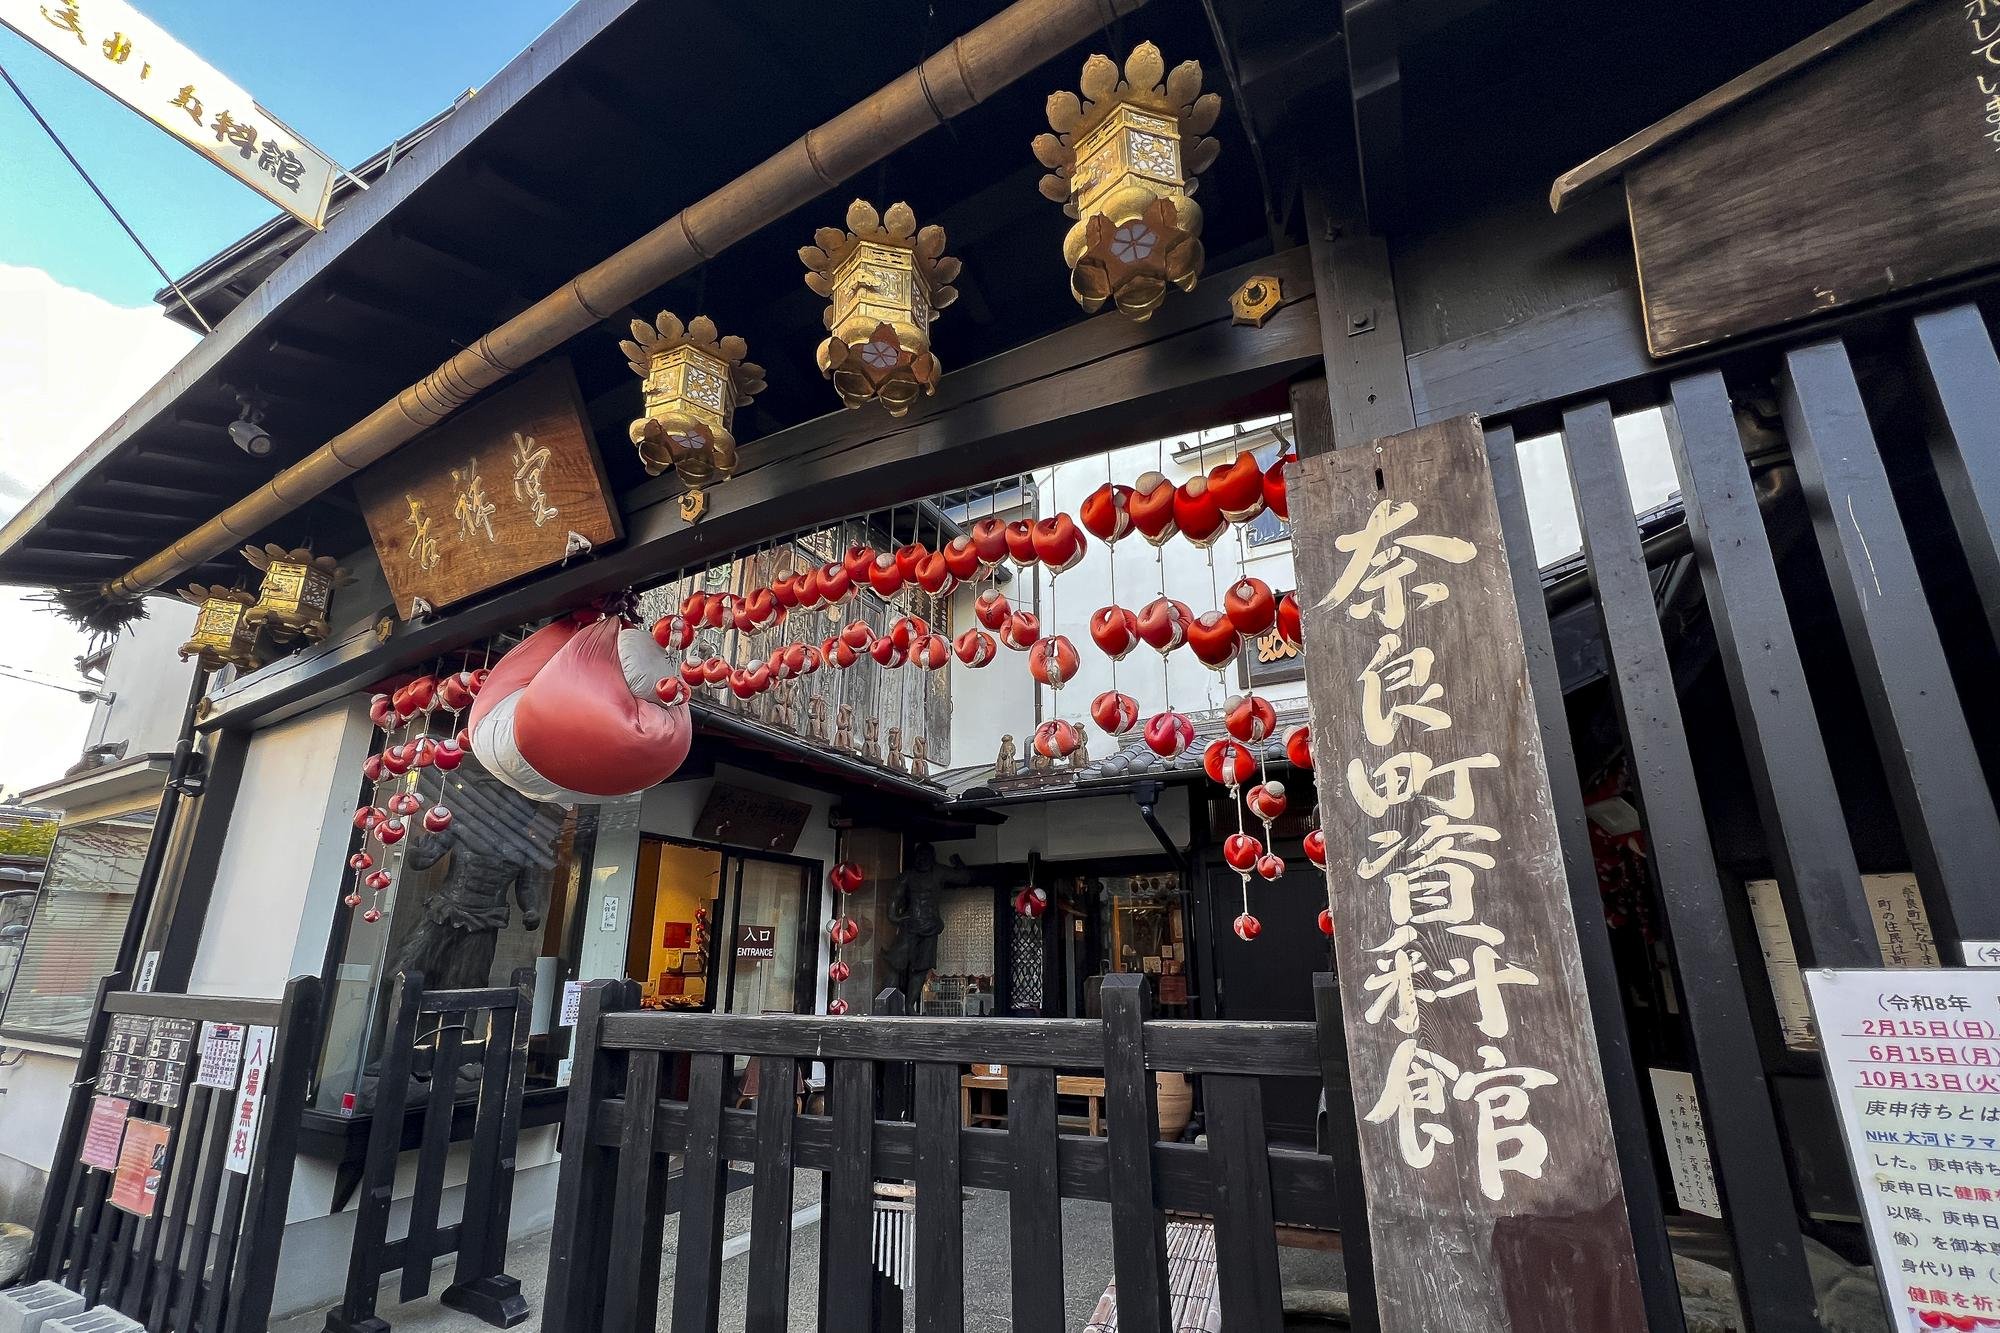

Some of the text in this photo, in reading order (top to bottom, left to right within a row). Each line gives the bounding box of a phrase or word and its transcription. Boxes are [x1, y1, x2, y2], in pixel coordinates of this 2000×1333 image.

[1311, 499, 1559, 1202] 奈良町資料館
[743, 926, 771, 942] 入口
[736, 947, 774, 957] ENTRANCE
[1859, 1070, 2000, 1092] 10月13日(火
[1865, 1130, 1900, 1143] NHK
[1907, 1285, 2000, 1313] 健康を祈
